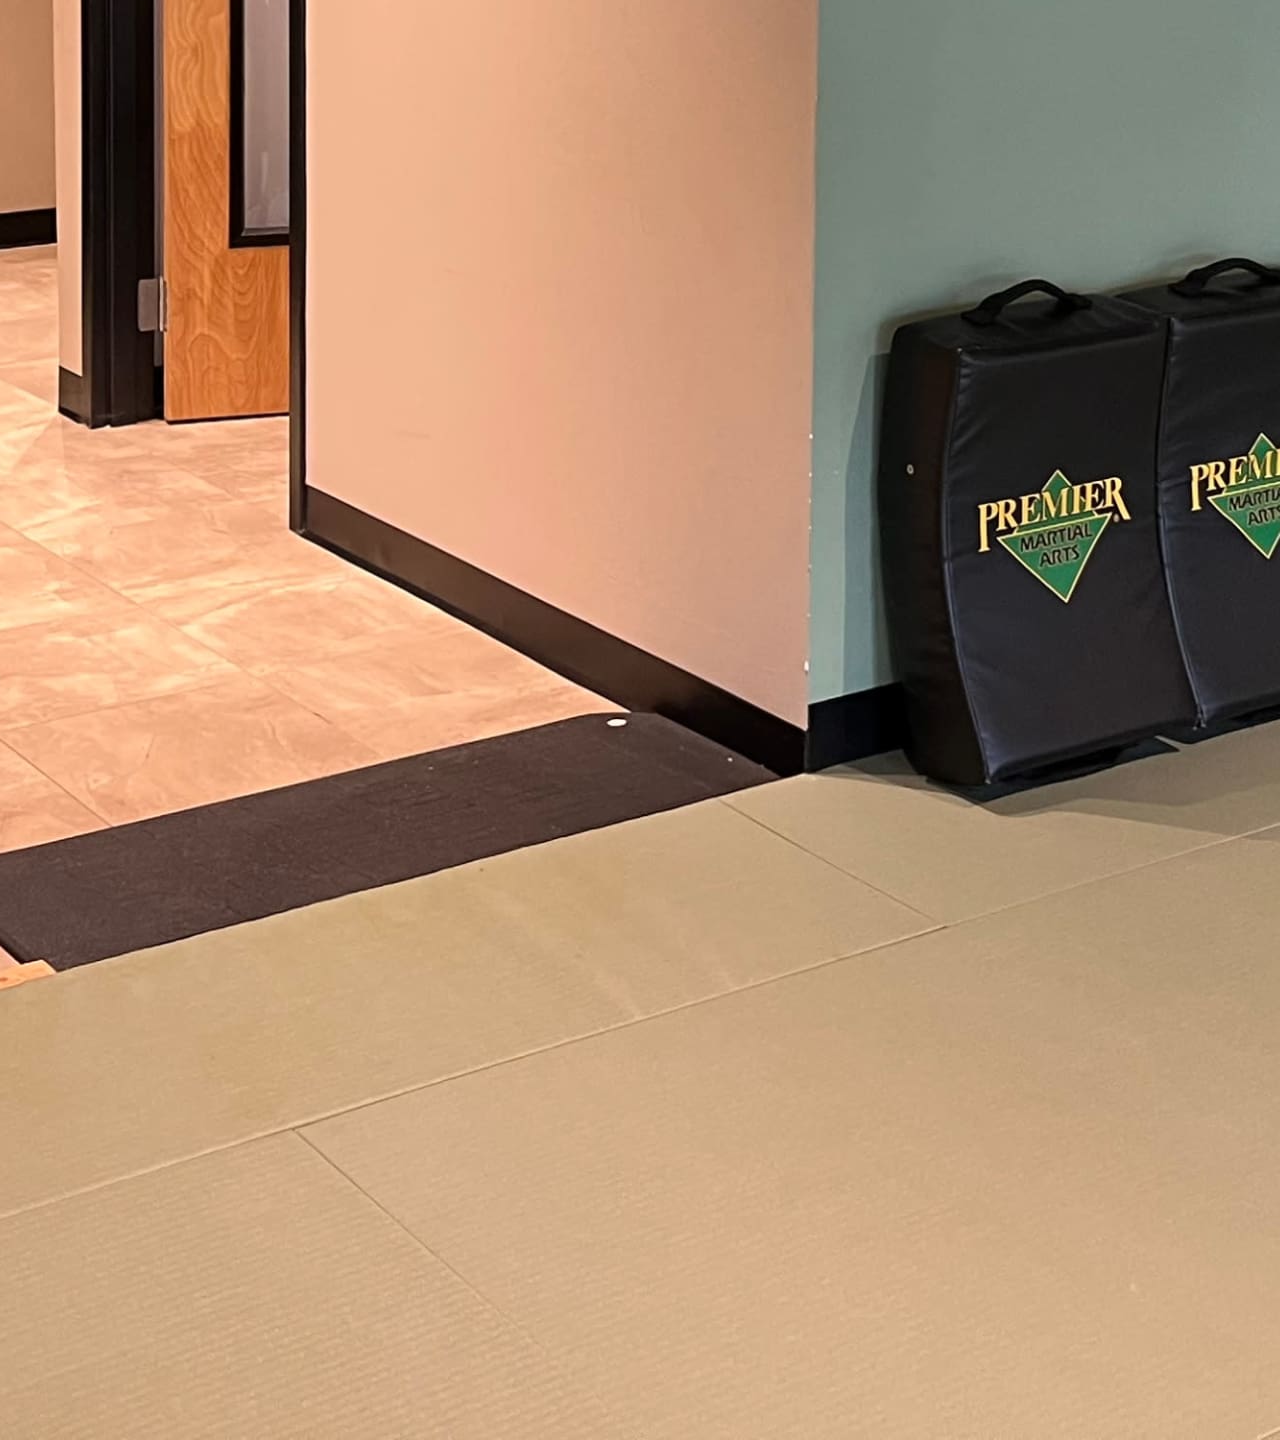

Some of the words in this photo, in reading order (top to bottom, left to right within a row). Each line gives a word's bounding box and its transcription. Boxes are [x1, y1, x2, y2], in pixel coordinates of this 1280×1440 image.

[978, 476, 1131, 552] PREMIER
[1019, 522, 1093, 553] MARTIAL
[1038, 543, 1081, 569] ARTS
